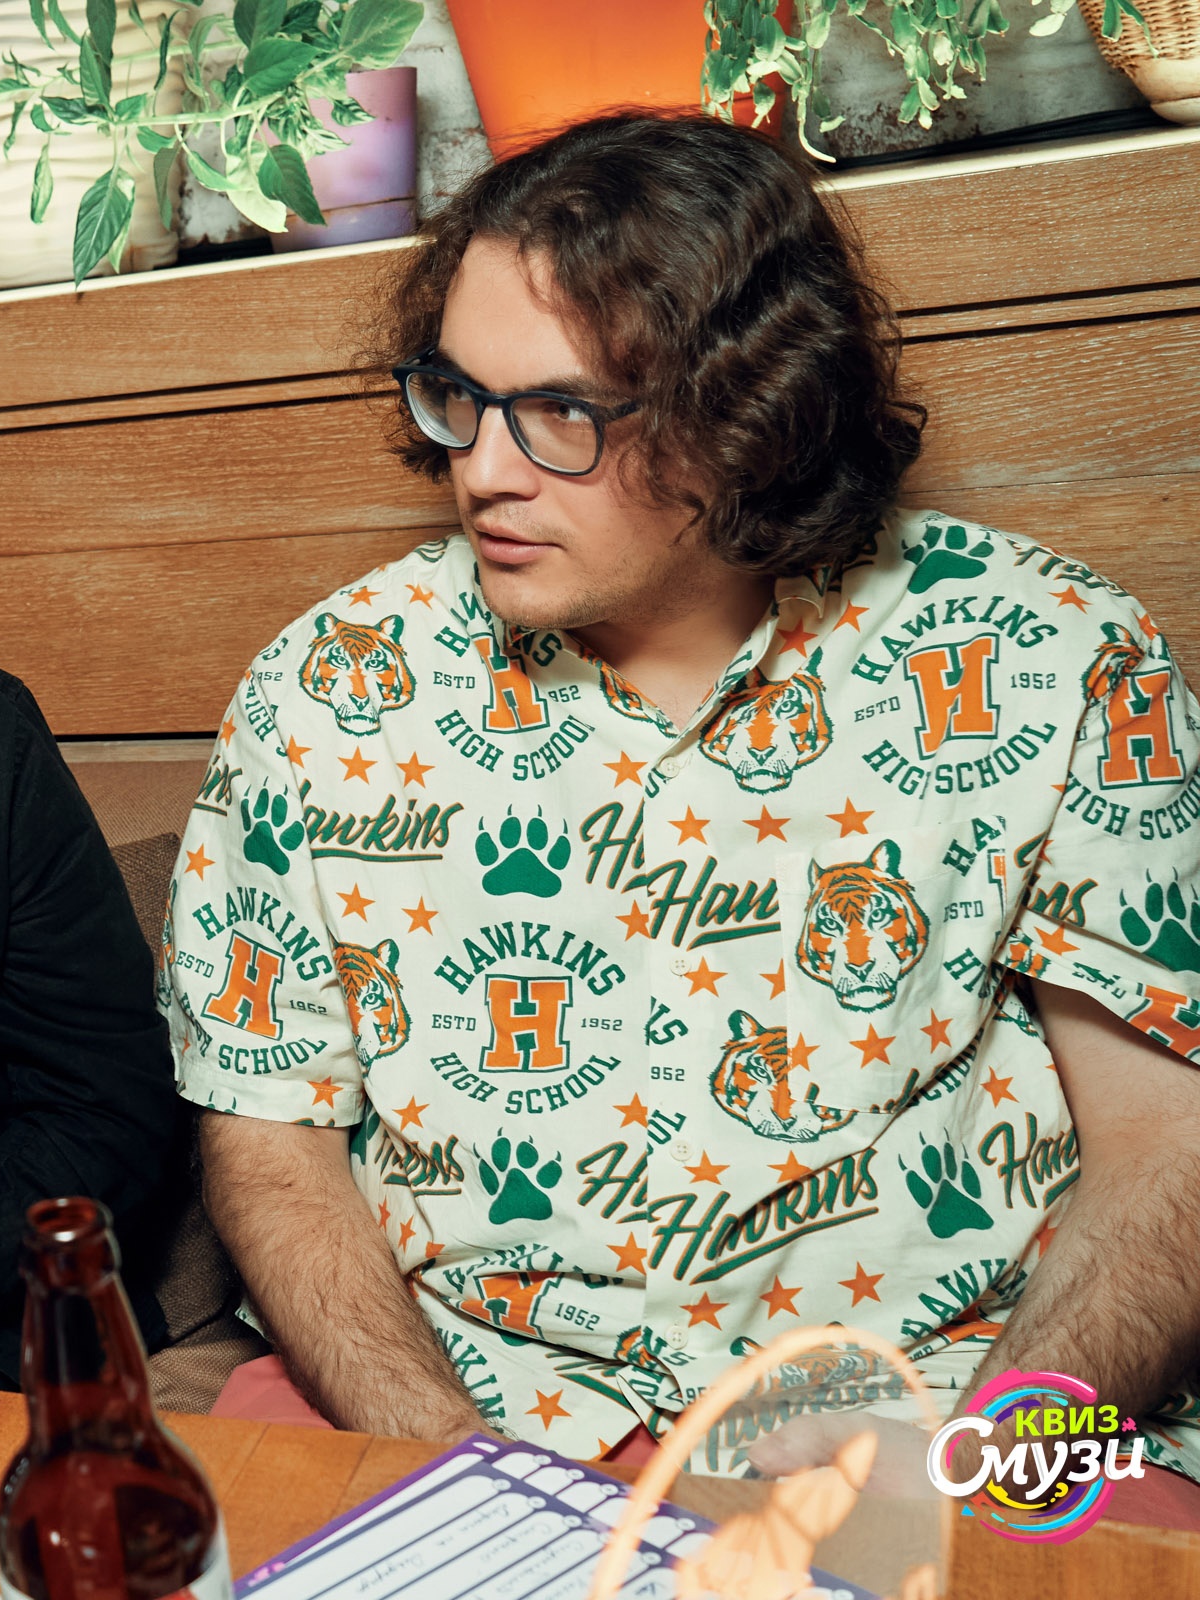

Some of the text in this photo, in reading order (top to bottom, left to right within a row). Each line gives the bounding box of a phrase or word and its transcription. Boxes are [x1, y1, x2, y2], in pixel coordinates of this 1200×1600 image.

[851, 596, 1059, 685] HAWKINS
[433, 671, 476, 689] ESTD
[903, 632, 1001, 761] H
[1010, 672, 1057, 690] 1952
[854, 695, 901, 723] ESTD
[435, 709, 504, 773] HIGH
[935, 722, 1058, 795] SCHOOL
[192, 886, 333, 981] HAWKINS
[434, 921, 626, 996] HAWKINS
[176, 951, 215, 979] ESTD
[200, 929, 286, 1041] H
[289, 999, 328, 1016] 1952
[431, 1014, 477, 1031] ESTD
[478, 973, 573, 1073] H
[580, 1017, 623, 1031] 1952
[218, 1037, 328, 1075] SCHOOL
[430, 1052, 622, 1115] HIGH SCHOOL
[555, 1302, 601, 1332] 1952
